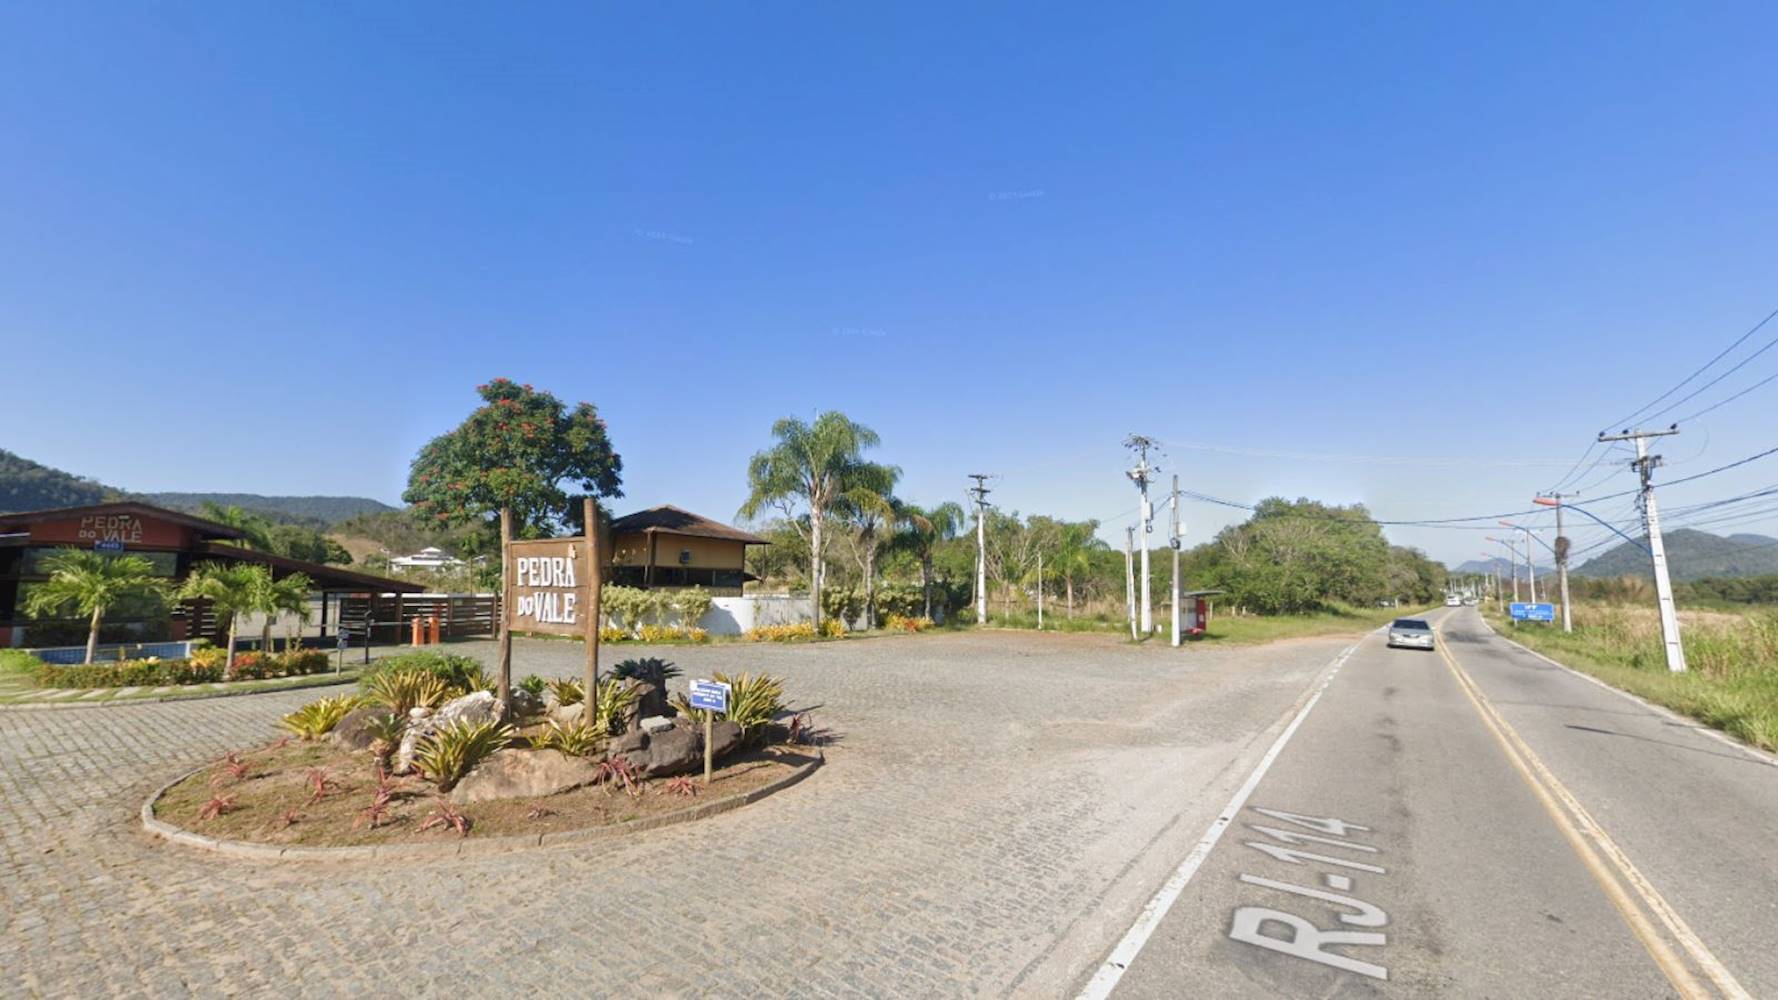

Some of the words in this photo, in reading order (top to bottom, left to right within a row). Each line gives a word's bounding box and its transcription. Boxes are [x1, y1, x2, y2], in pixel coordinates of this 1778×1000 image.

[81, 515, 142, 530] PEDRA
[102, 529, 142, 543] VALE
[517, 596, 534, 616] DO
[533, 591, 576, 624] VALE
[1229, 806, 1389, 981] RJ-114
